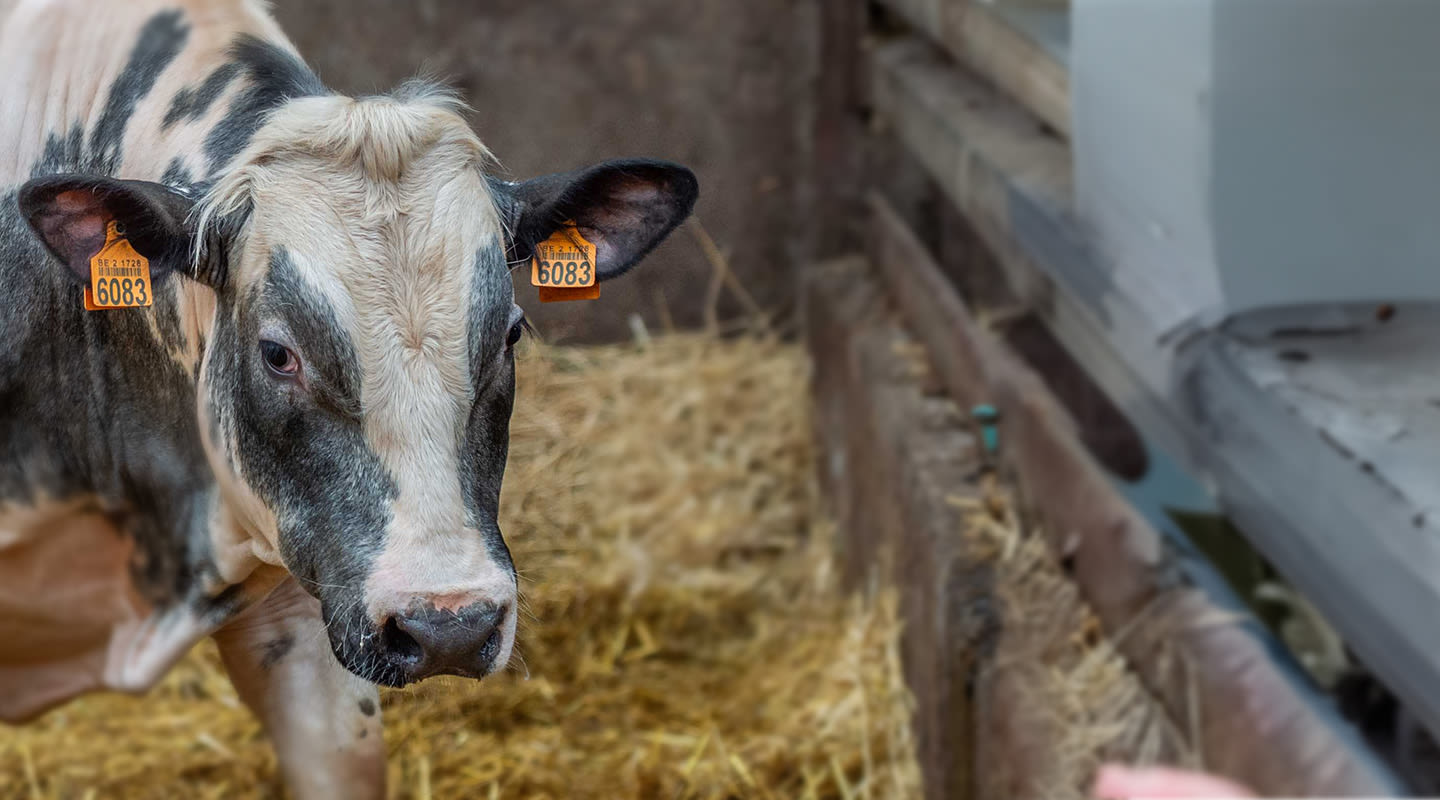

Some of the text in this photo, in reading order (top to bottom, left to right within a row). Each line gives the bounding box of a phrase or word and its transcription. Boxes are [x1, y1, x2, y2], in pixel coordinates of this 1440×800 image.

[98, 258, 109, 267] BE
[539, 261, 591, 285] 6083
[98, 278, 147, 306] 6083
